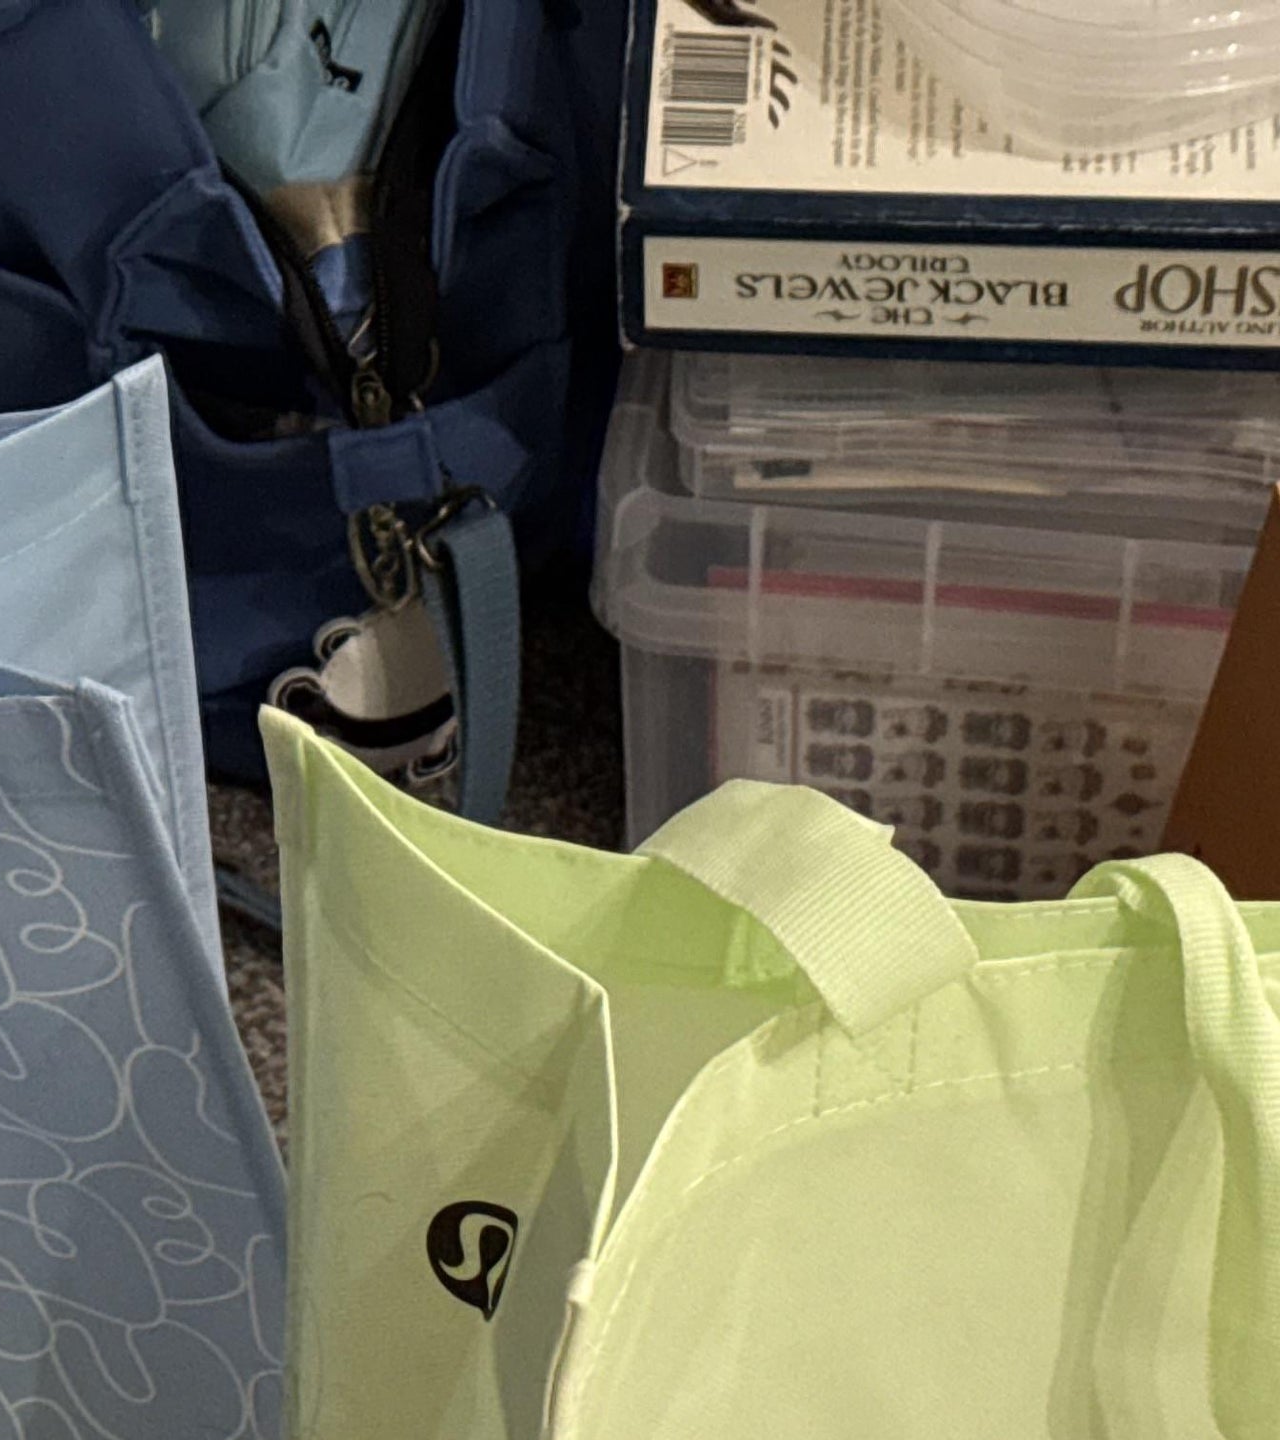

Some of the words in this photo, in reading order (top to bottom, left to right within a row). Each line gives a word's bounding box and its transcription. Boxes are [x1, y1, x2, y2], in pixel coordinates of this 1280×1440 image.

[838, 253, 970, 274] TRILOGY
[736, 272, 922, 302] JEWELS
[928, 277, 1068, 308] BLACK
[870, 305, 935, 326] THE
[1139, 318, 1232, 334] AUTHOR
